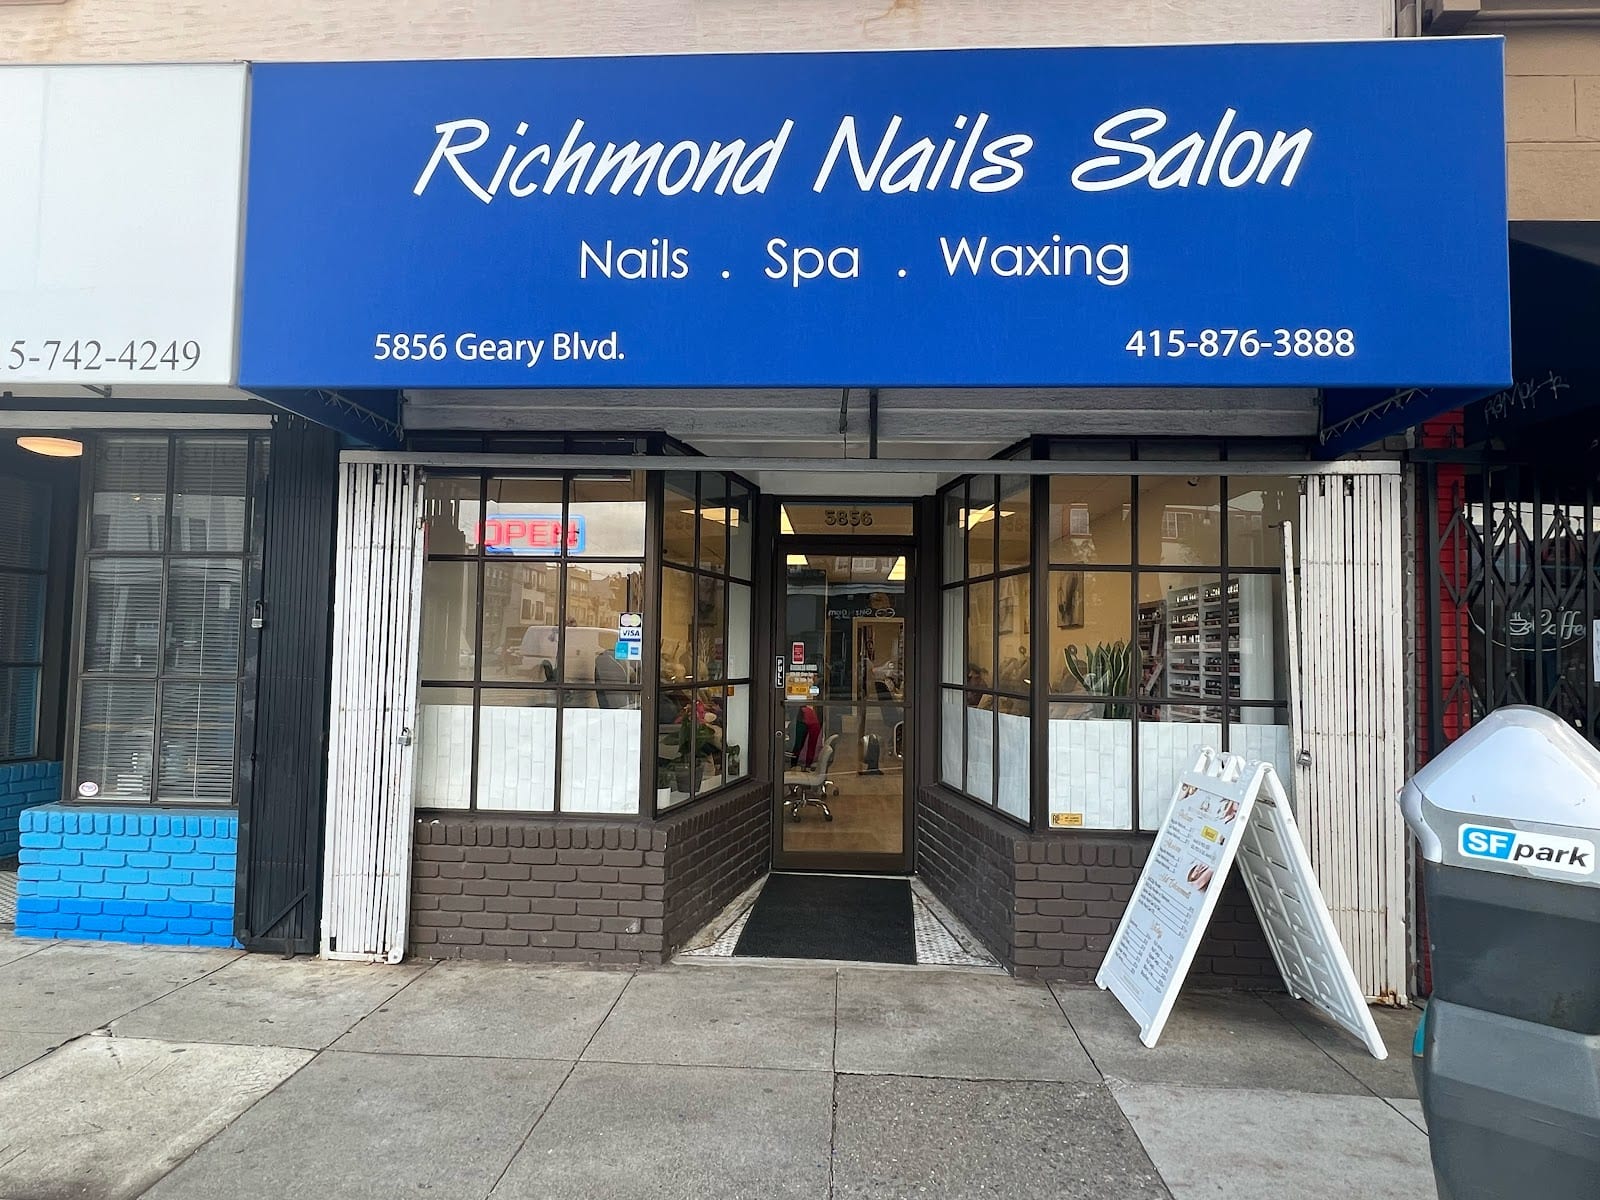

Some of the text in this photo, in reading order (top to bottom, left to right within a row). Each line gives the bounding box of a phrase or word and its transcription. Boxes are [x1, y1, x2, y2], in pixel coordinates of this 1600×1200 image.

[414, 107, 1313, 205] Richmond Nails Salon
[580, 238, 689, 280] Nails
[764, 237, 859, 288] Spa
[939, 234, 1129, 286] Waxing
[0, 340, 201, 371] 5-742-4249
[374, 331, 625, 368] 5856 Geary Blvd.
[1125, 328, 1355, 357] 415-876-3888
[475, 519, 577, 546] OPEN
[824, 509, 873, 527] 5856
[622, 629, 640, 637] VISA
